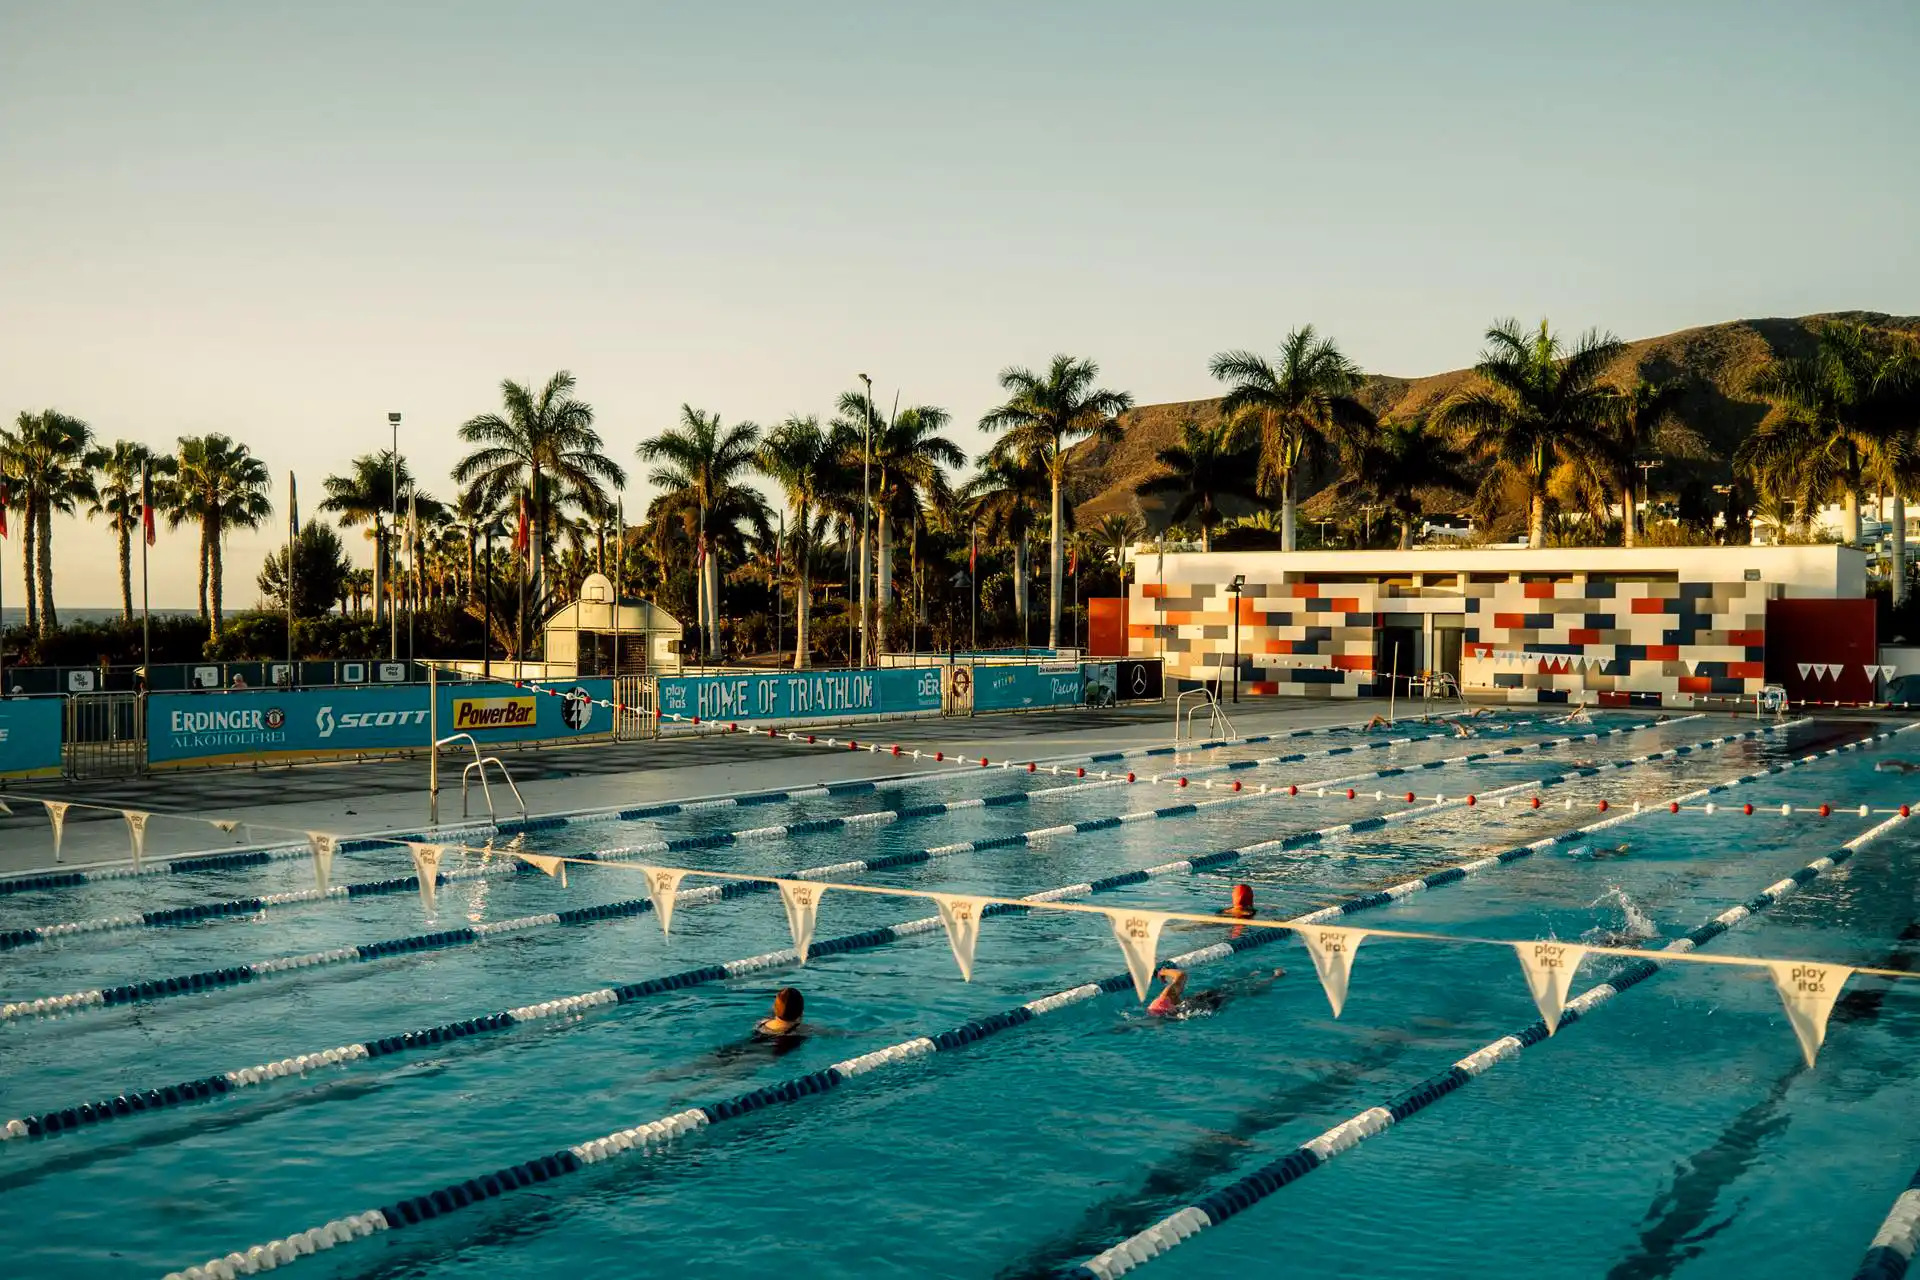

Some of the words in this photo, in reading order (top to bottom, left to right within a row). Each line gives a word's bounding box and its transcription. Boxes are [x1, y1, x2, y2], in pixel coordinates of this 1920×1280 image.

[665, 684, 686, 699] play
[698, 681, 748, 718] HOME
[758, 679, 779, 713] OF
[788, 676, 873, 712] TRIATHLON
[669, 698, 686, 709] itas
[171, 709, 264, 733] ERDINGER
[337, 710, 430, 728] SCOTT
[457, 702, 534, 726] PowerBar
[171, 731, 286, 748] ALKOHOLFREI
[1126, 917, 1150, 930] play
[1535, 944, 1566, 958] play
[1540, 956, 1564, 967] itas
[1792, 965, 1827, 982] play
[1798, 979, 1825, 992] itas
